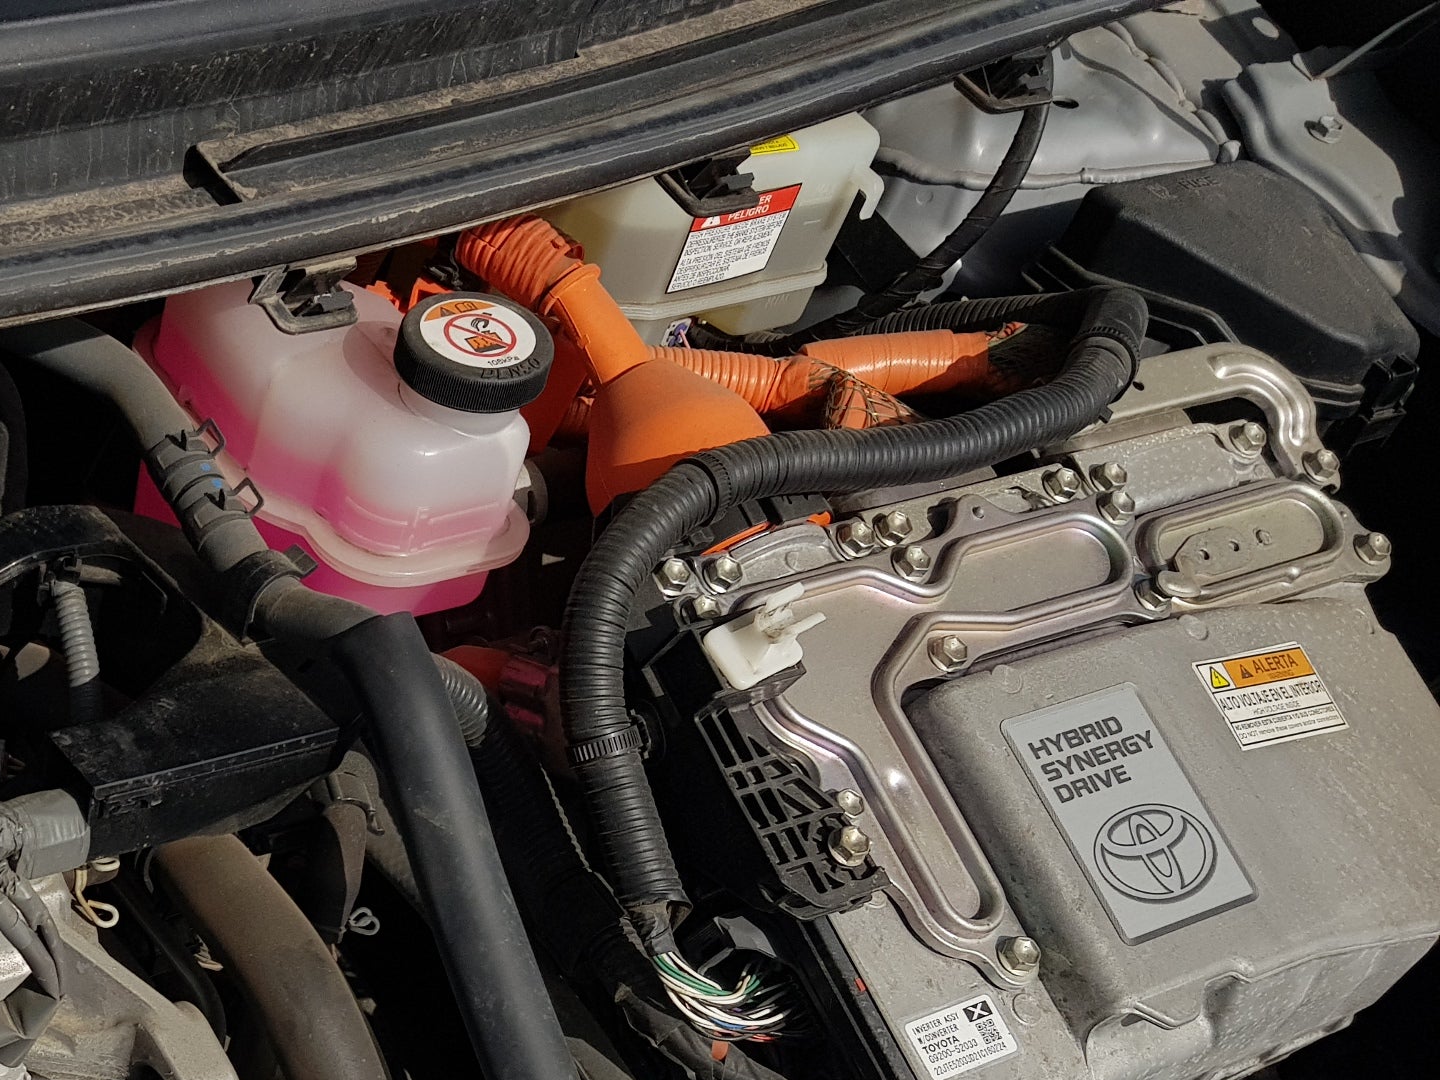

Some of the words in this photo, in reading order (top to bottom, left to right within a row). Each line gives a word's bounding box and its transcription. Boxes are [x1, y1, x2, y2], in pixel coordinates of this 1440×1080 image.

[728, 204, 770, 221] PELIGRO
[1252, 653, 1298, 674] ALERTA
[1220, 696, 1241, 712] ALTO
[1241, 688, 1269, 708] VOLTAJE
[1268, 688, 1281, 703] EN
[1280, 686, 1293, 700] EL
[1291, 680, 1324, 697] INTERIOR
[1028, 716, 1123, 760] HYBRID
[1040, 729, 1154, 782] SYNERGY
[1053, 764, 1132, 803] DRIVE
[912, 1018, 942, 1035] INVERTER
[944, 1012, 960, 1023] ASSY
[922, 1035, 960, 1055] TOYOTA
